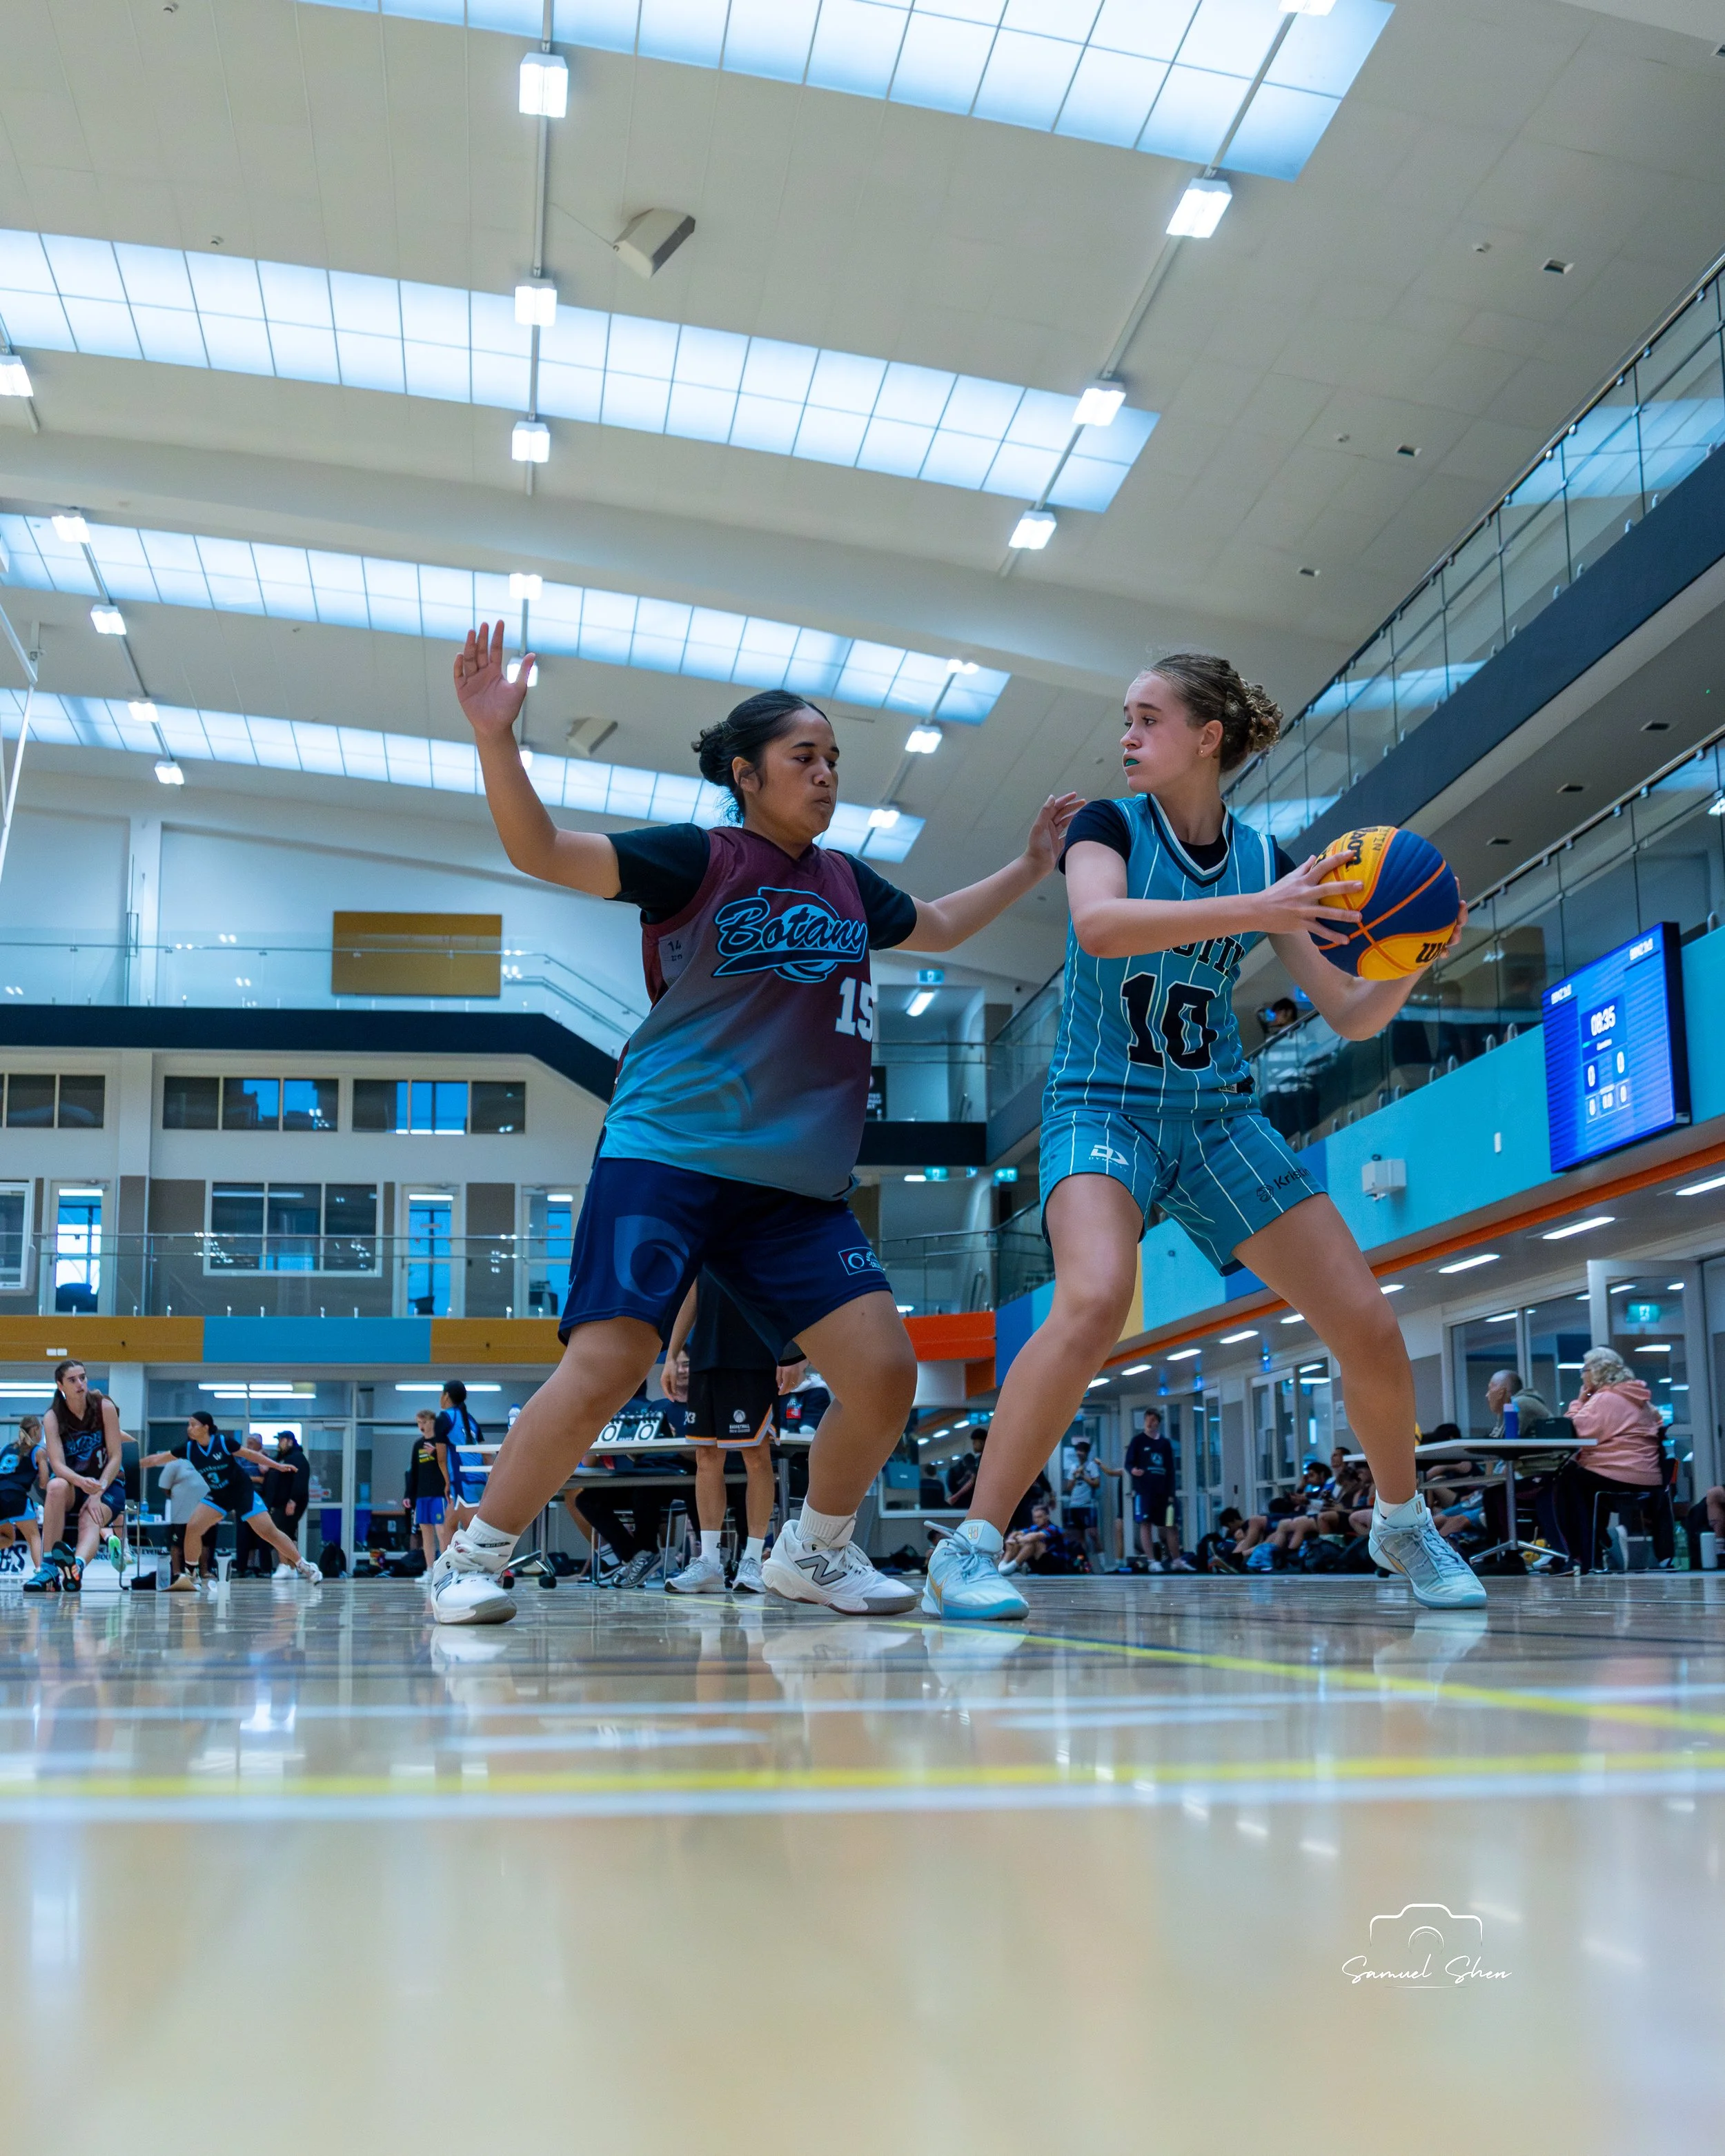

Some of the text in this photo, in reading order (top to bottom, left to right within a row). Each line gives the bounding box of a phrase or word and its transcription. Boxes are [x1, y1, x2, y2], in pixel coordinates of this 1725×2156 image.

[713, 897, 868, 962] Botany
[1121, 971, 1219, 1071] 10
[1590, 1005, 1615, 1036] 08:35
[638, 1424, 654, 1441] 0
